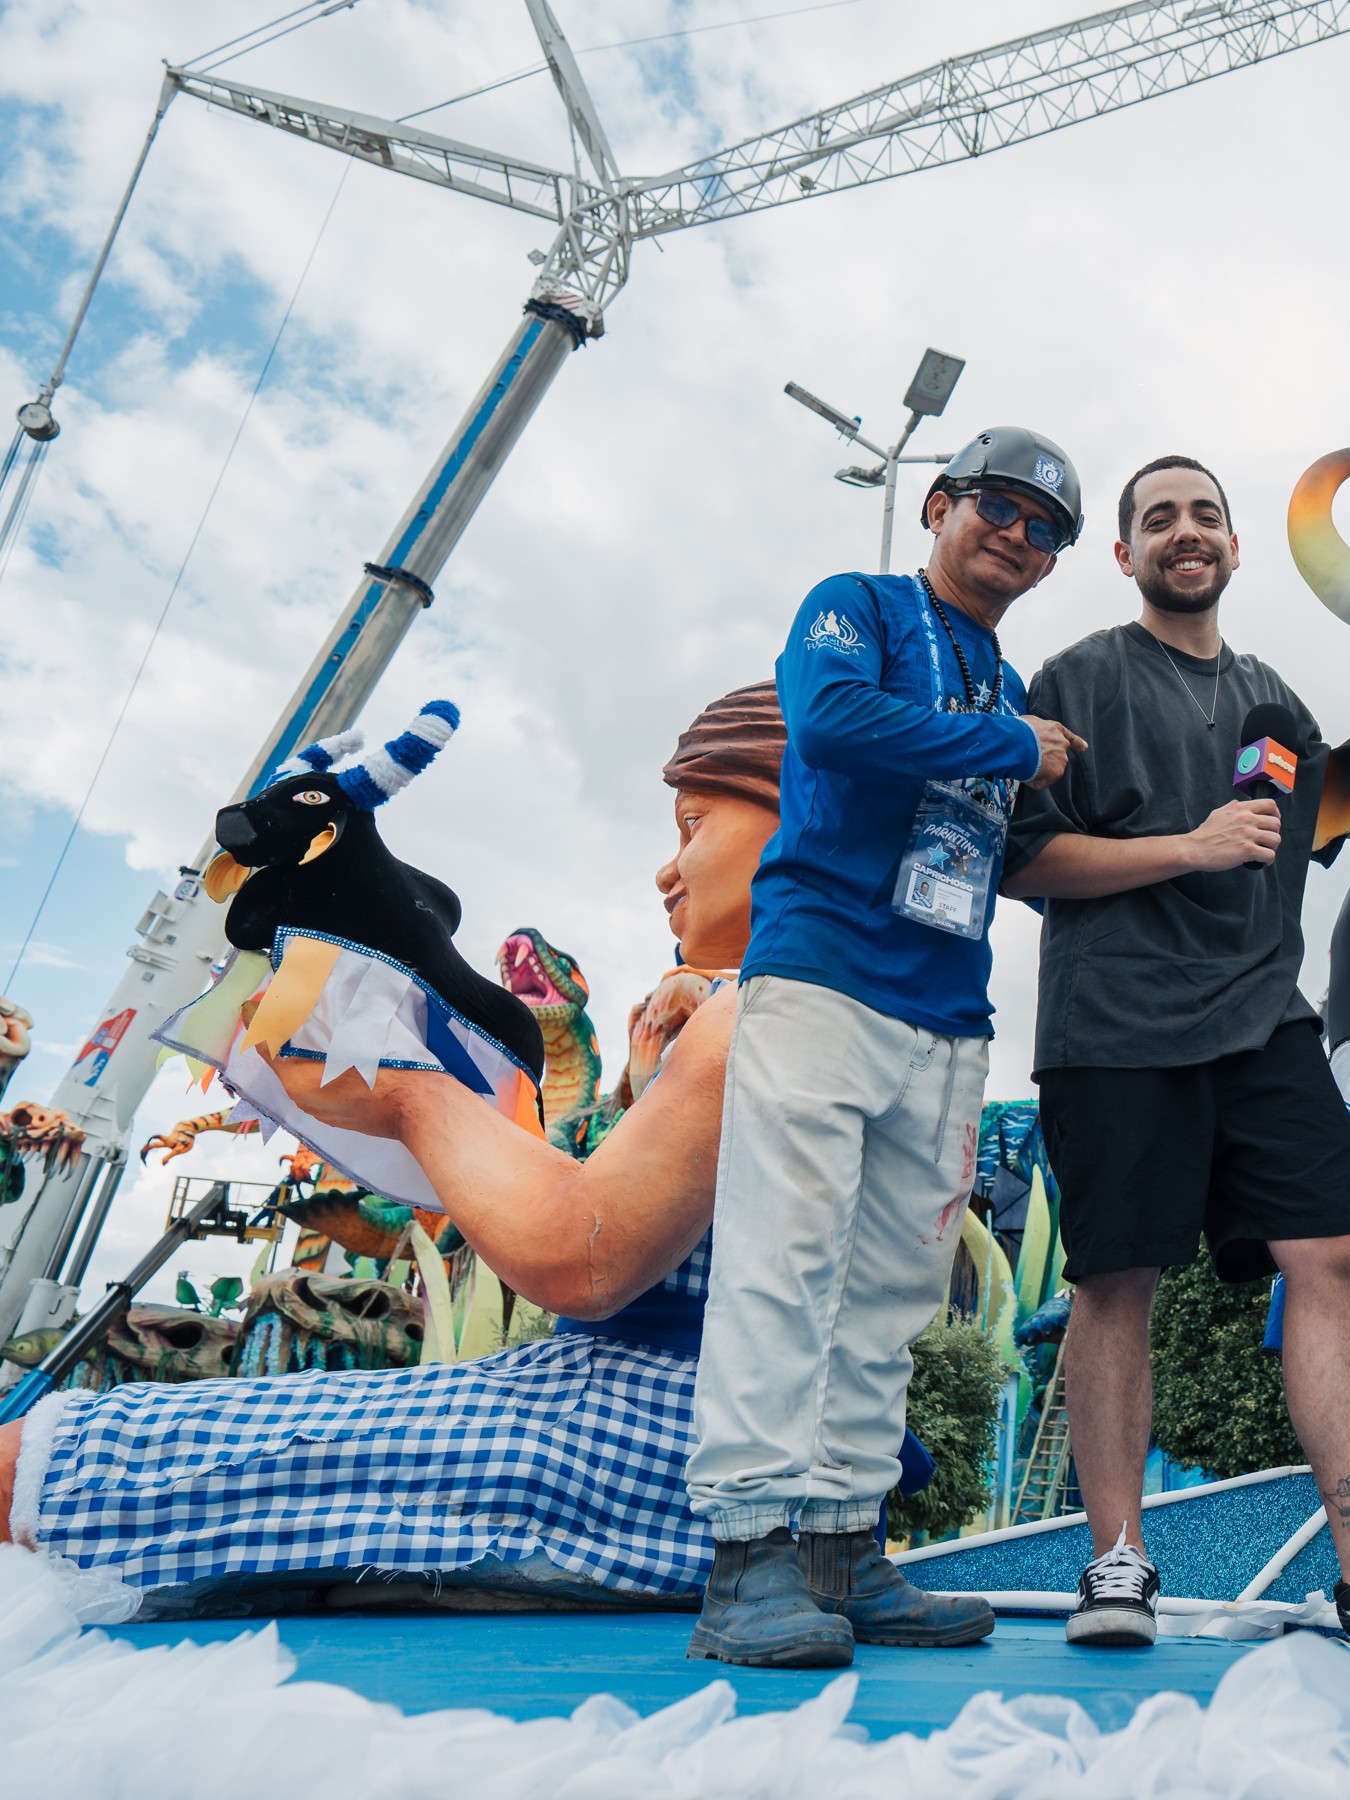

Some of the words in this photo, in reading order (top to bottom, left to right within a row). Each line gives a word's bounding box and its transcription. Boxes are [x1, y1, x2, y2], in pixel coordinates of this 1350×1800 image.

[923, 824, 980, 859] PARINTINS
[913, 862, 974, 892] CAPRICHOSO
[939, 902, 958, 913] STAFF
